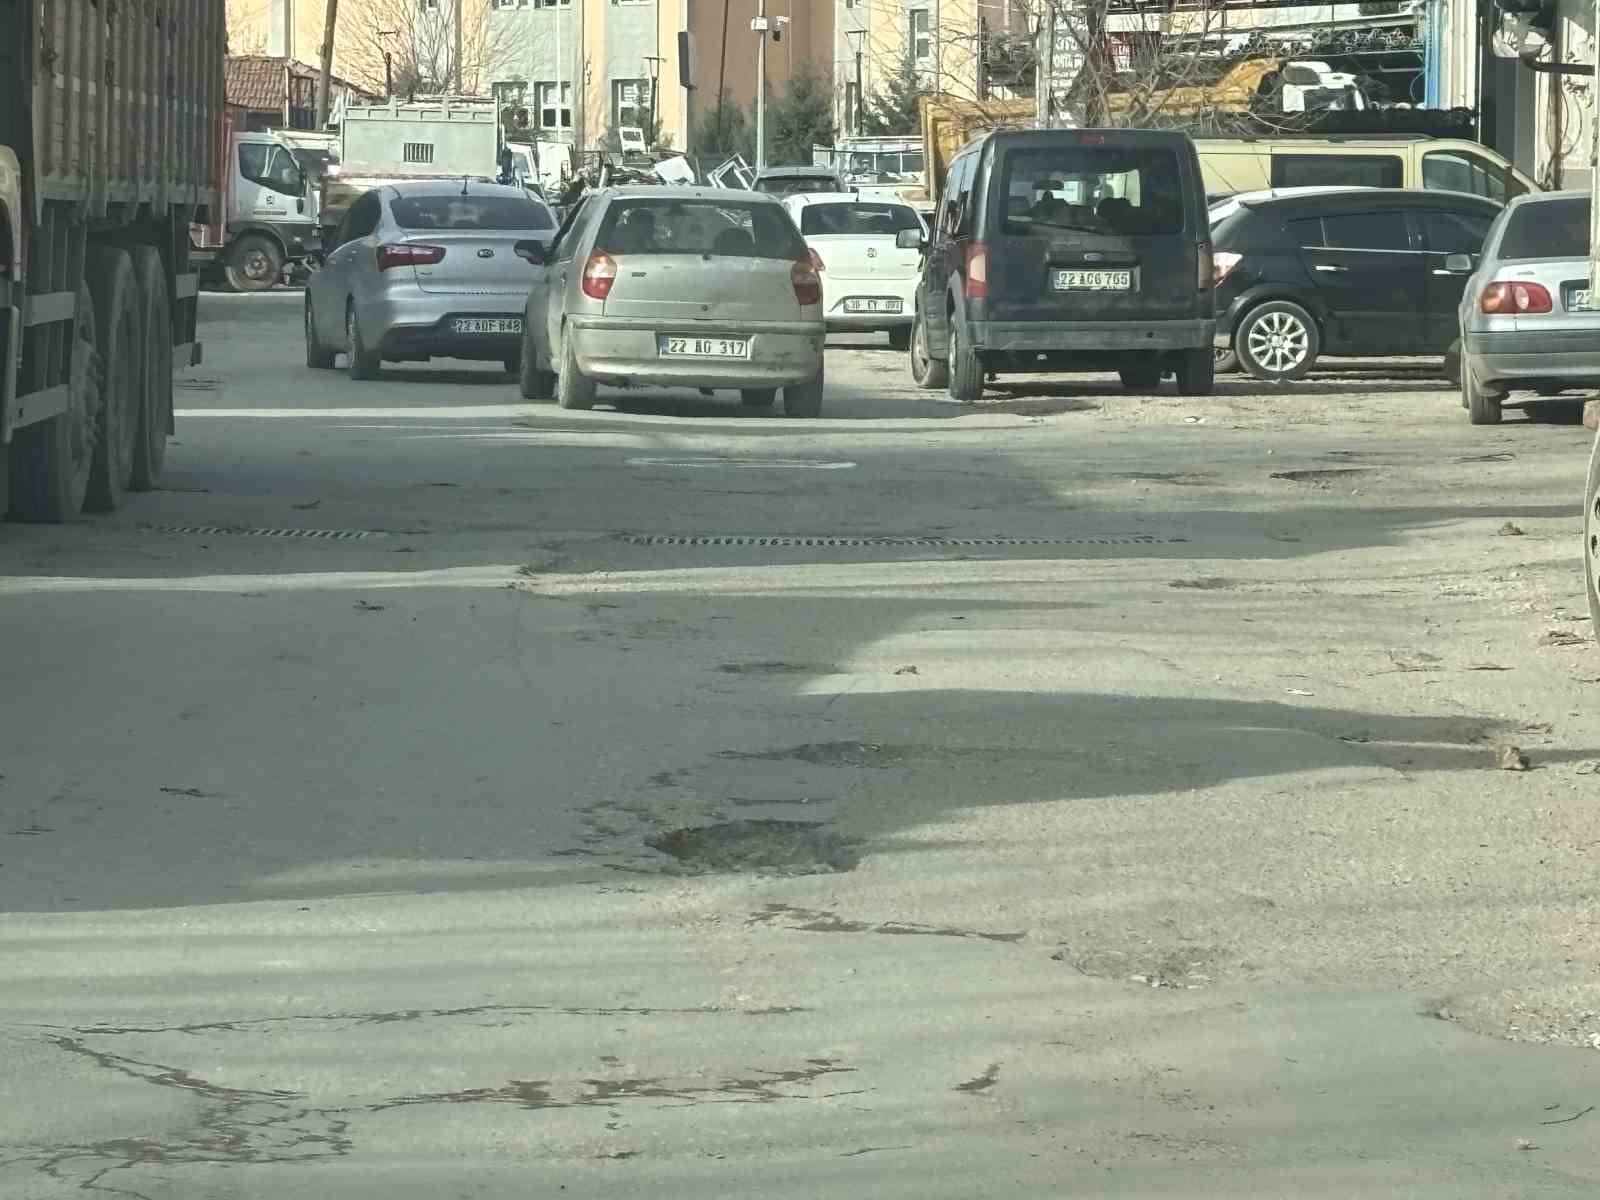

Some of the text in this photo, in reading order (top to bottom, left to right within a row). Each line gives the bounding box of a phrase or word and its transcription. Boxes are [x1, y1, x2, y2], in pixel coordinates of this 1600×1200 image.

[1061, 272, 1076, 285] 22
[670, 339, 687, 353] 22
[719, 340, 745, 355] 317
